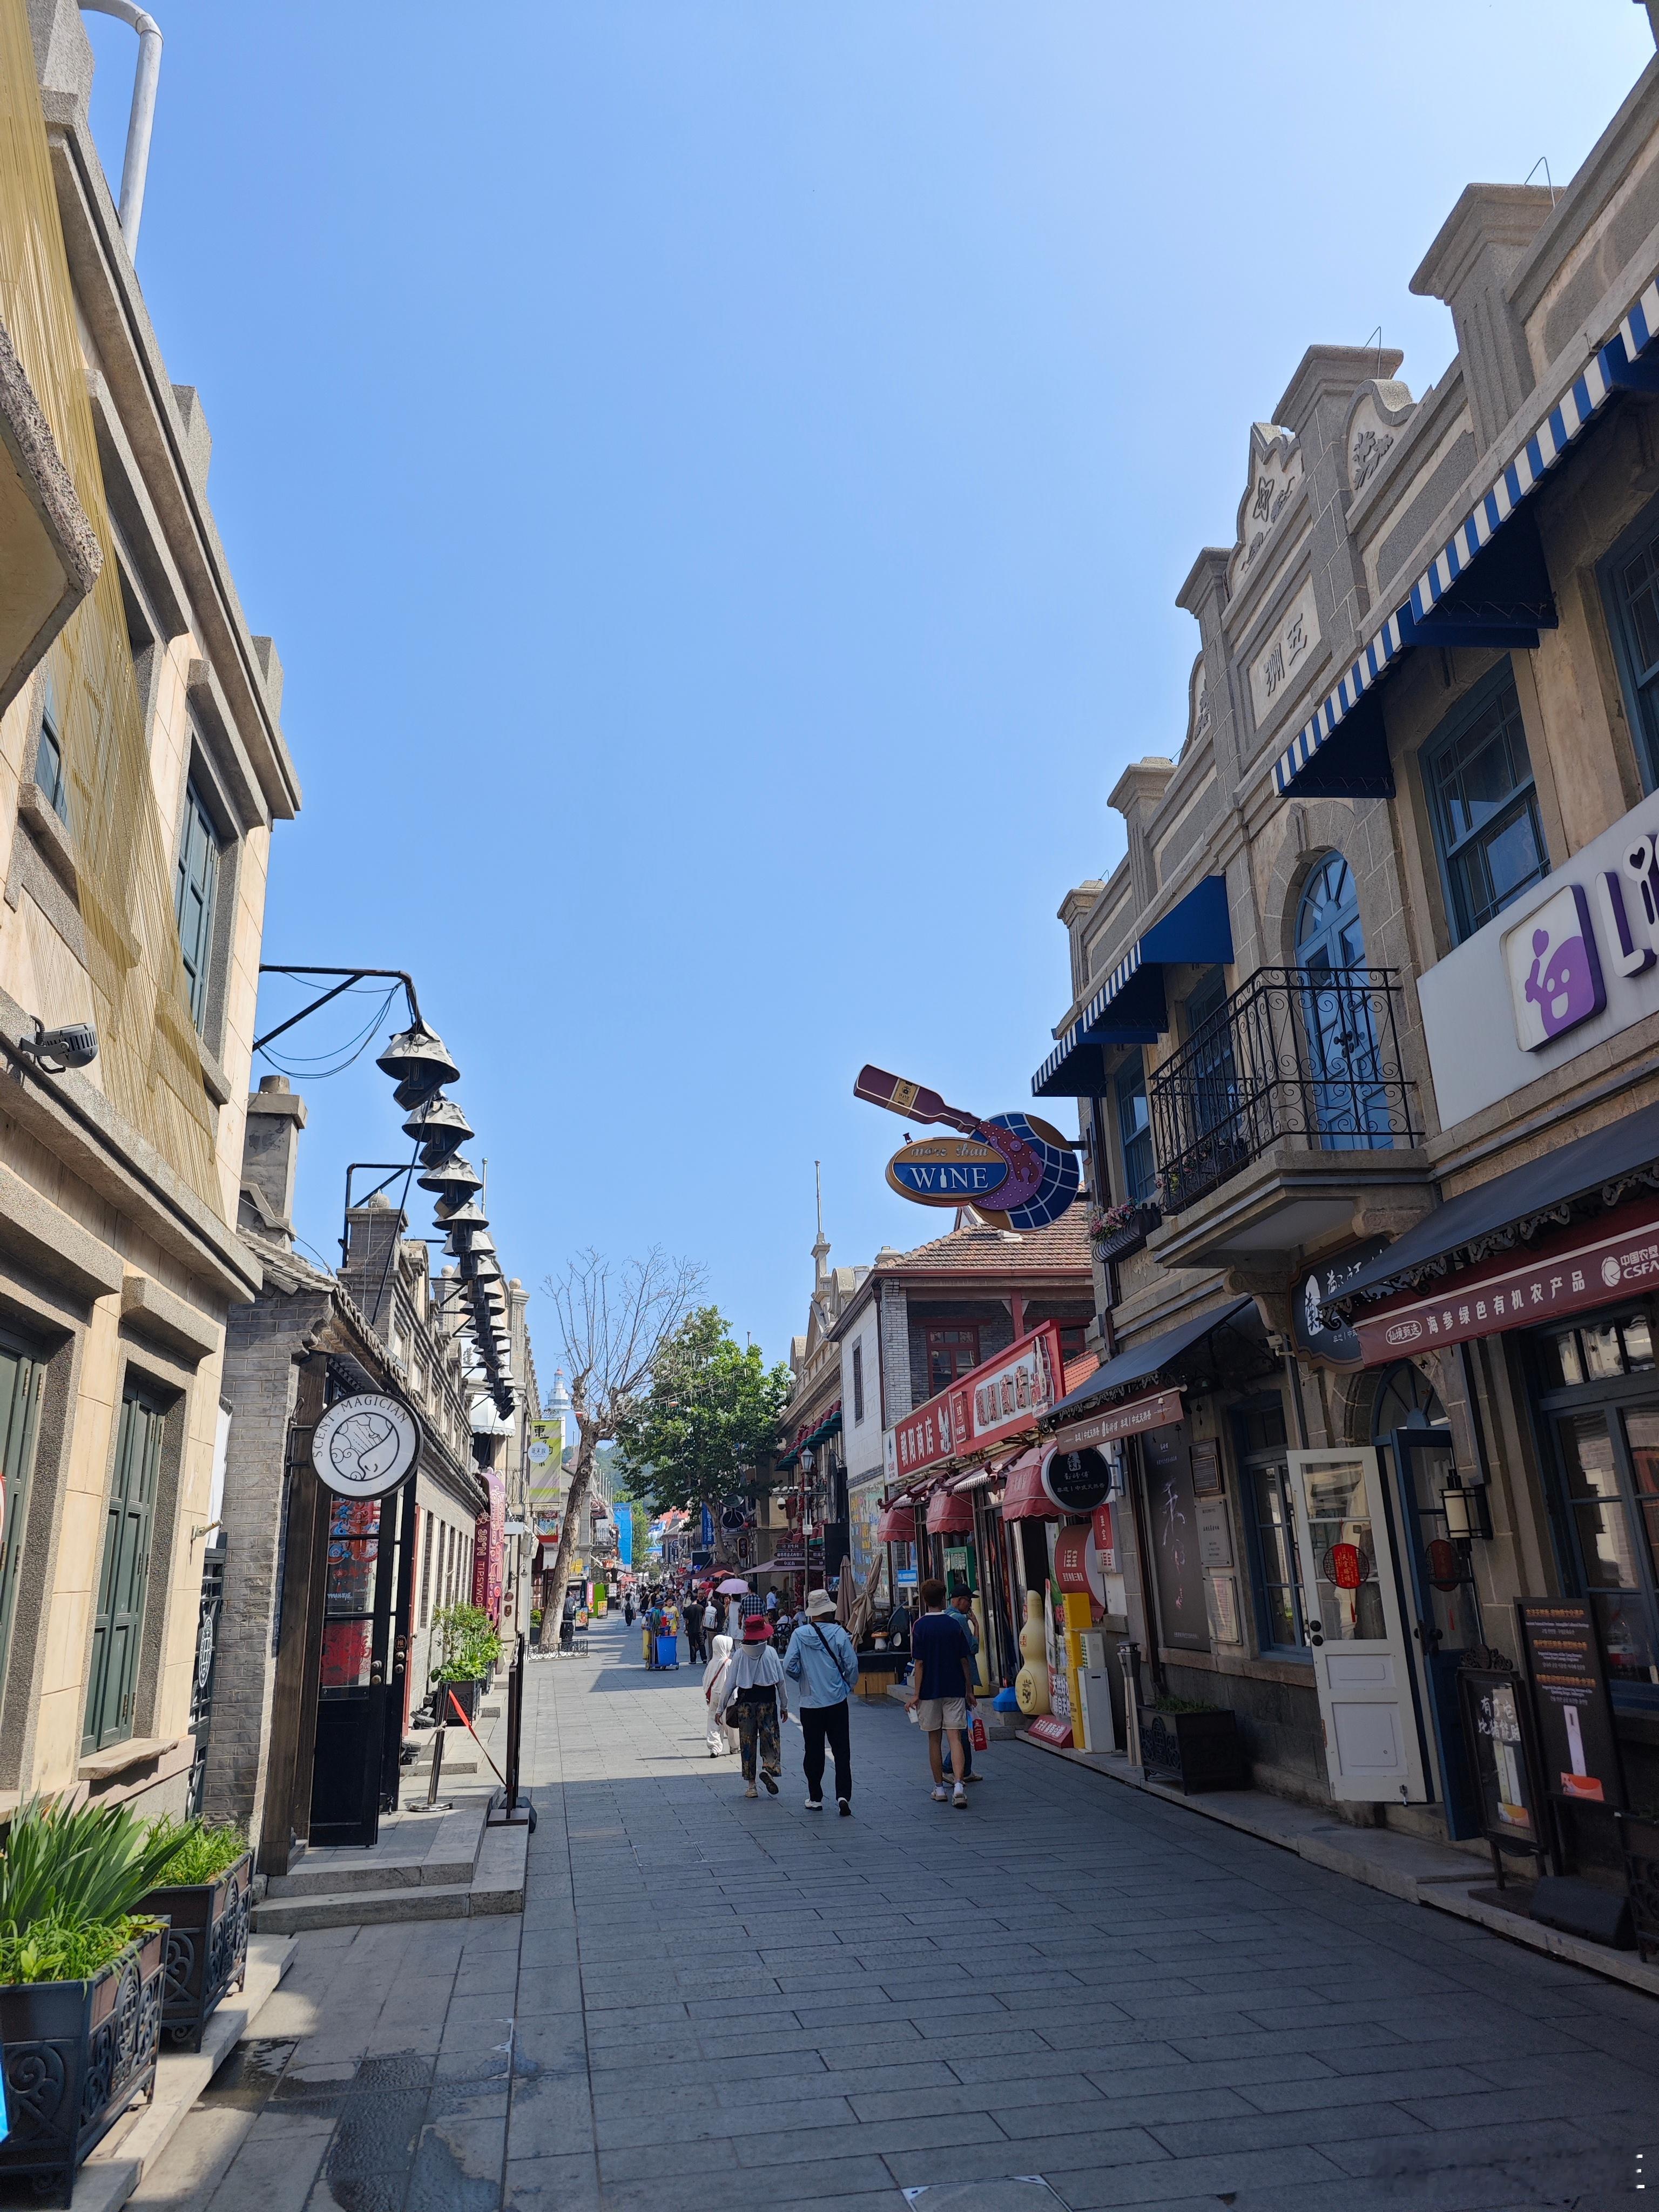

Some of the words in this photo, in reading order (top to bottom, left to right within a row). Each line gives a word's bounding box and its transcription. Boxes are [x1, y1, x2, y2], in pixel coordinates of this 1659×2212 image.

[1595, 834, 1659, 977] Li
[911, 1147, 948, 1157] more
[956, 1143, 989, 1157] than
[1620, 1244, 1659, 1266] 中国农垦
[1426, 1270, 1585, 1334] 海参绿色有机农产品
[313, 1413, 335, 1458] SCENT
[340, 1395, 409, 1424] MAGICIAN
[900, 1415, 934, 1467] 朝阳商店
[1480, 1695, 1514, 1721] 有了它
